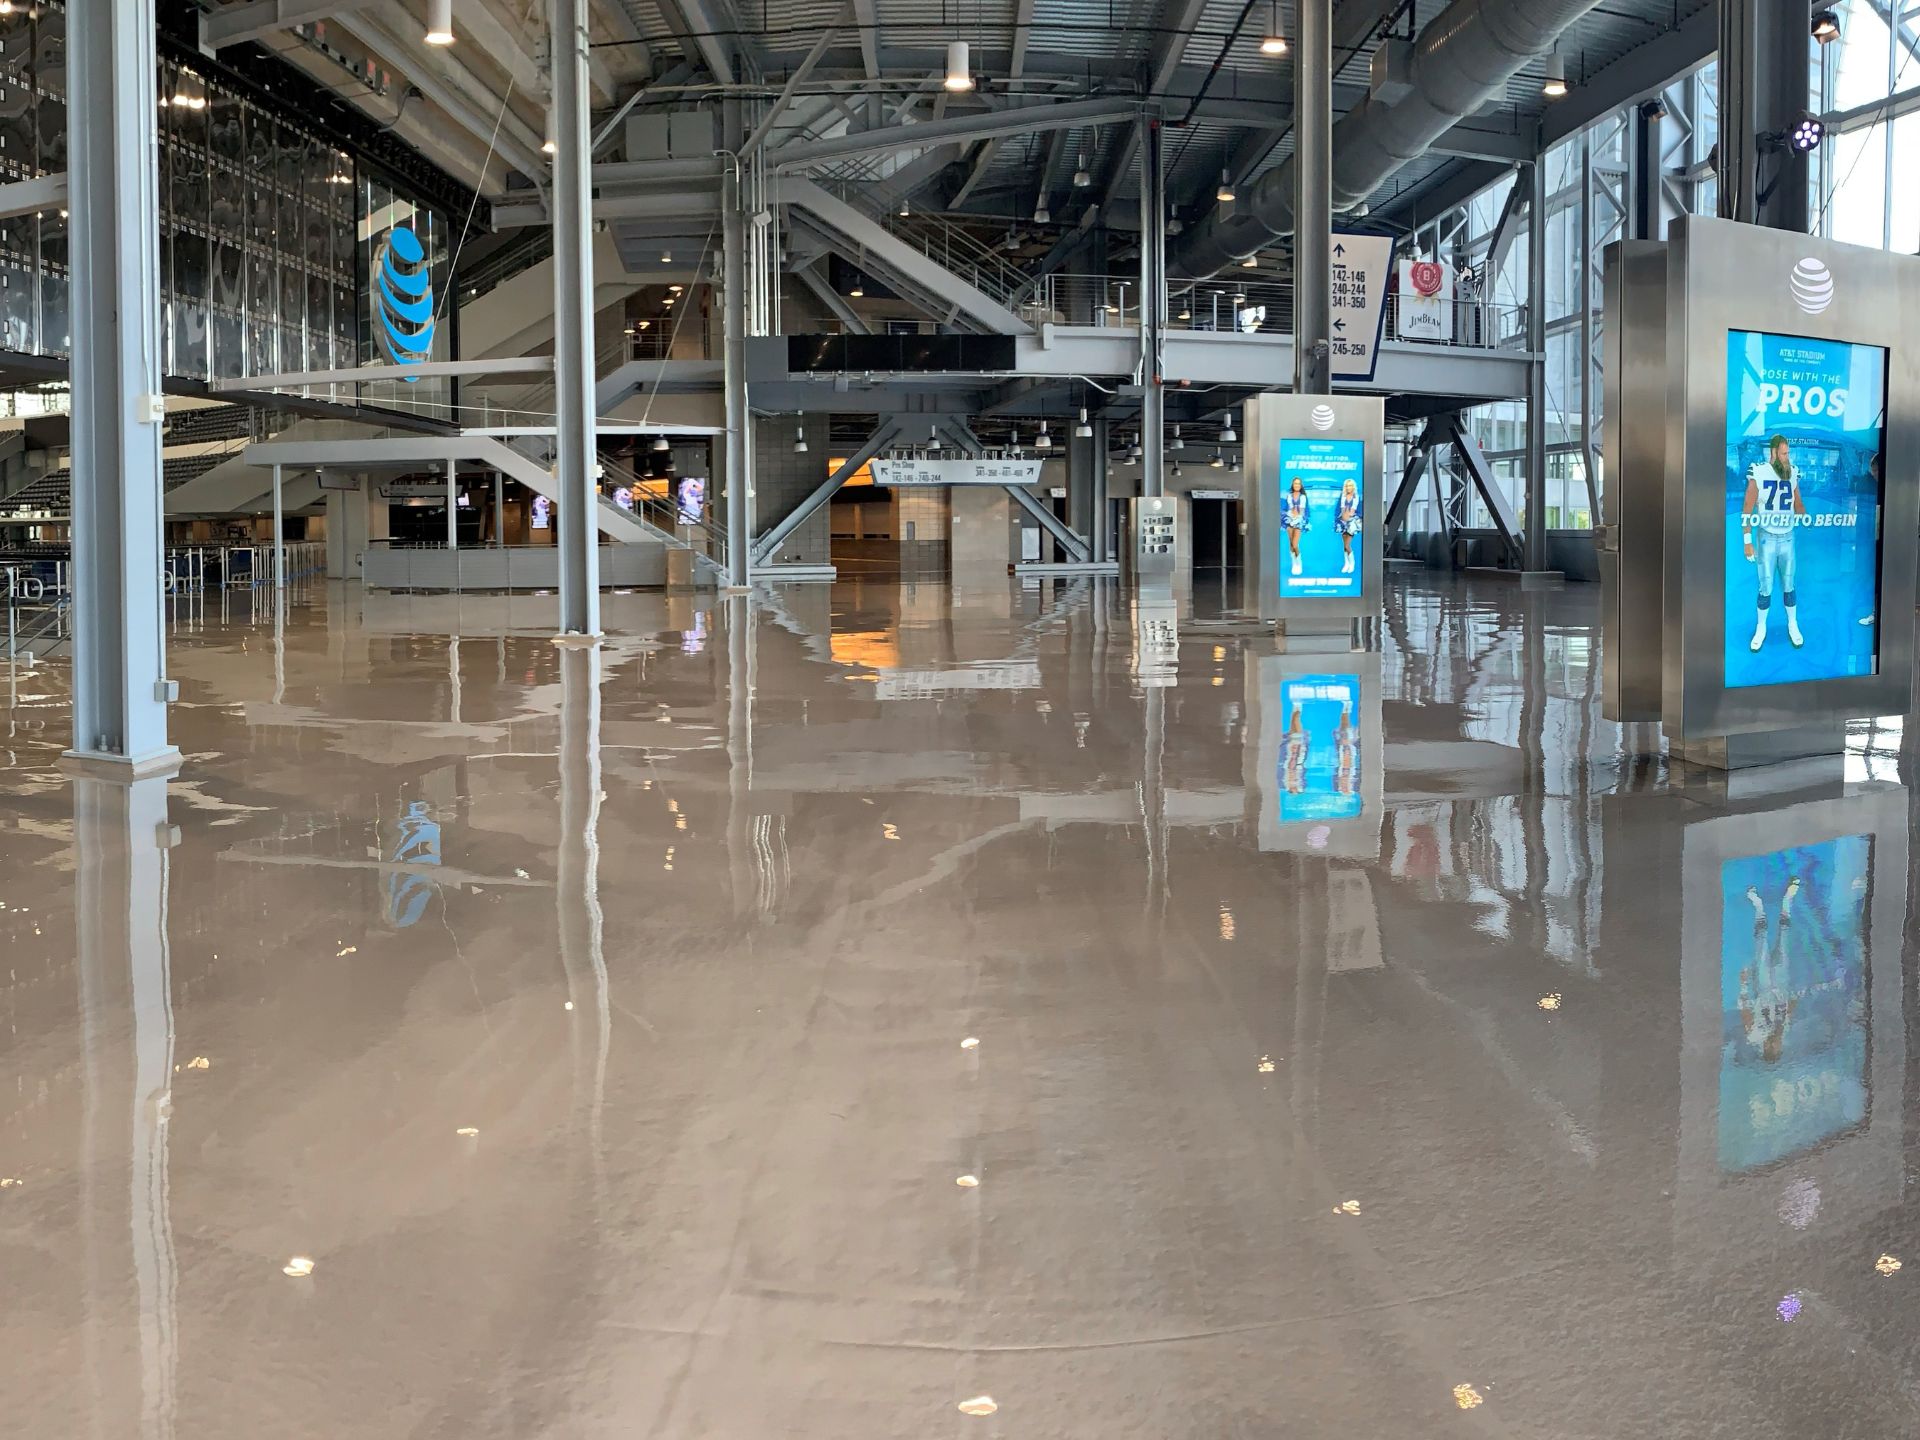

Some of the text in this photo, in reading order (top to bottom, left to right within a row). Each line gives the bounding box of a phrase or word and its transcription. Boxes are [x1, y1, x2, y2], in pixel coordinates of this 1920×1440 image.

[1332, 270, 1365, 283] 142-146
[1332, 283, 1366, 296] 240-244
[1332, 296, 1366, 309] 341-350
[1332, 343, 1366, 356] 245-250
[1779, 348, 1826, 361] AT&T STADIUM
[1761, 369, 1841, 385] POSE WITH THE
[1755, 382, 1850, 418] PROS
[890, 450, 1026, 461] MAIN CONCOURSE
[902, 461, 915, 469] Shop
[1763, 480, 1793, 511] 72
[1740, 512, 1858, 528] TOUCH TO BEGIN
